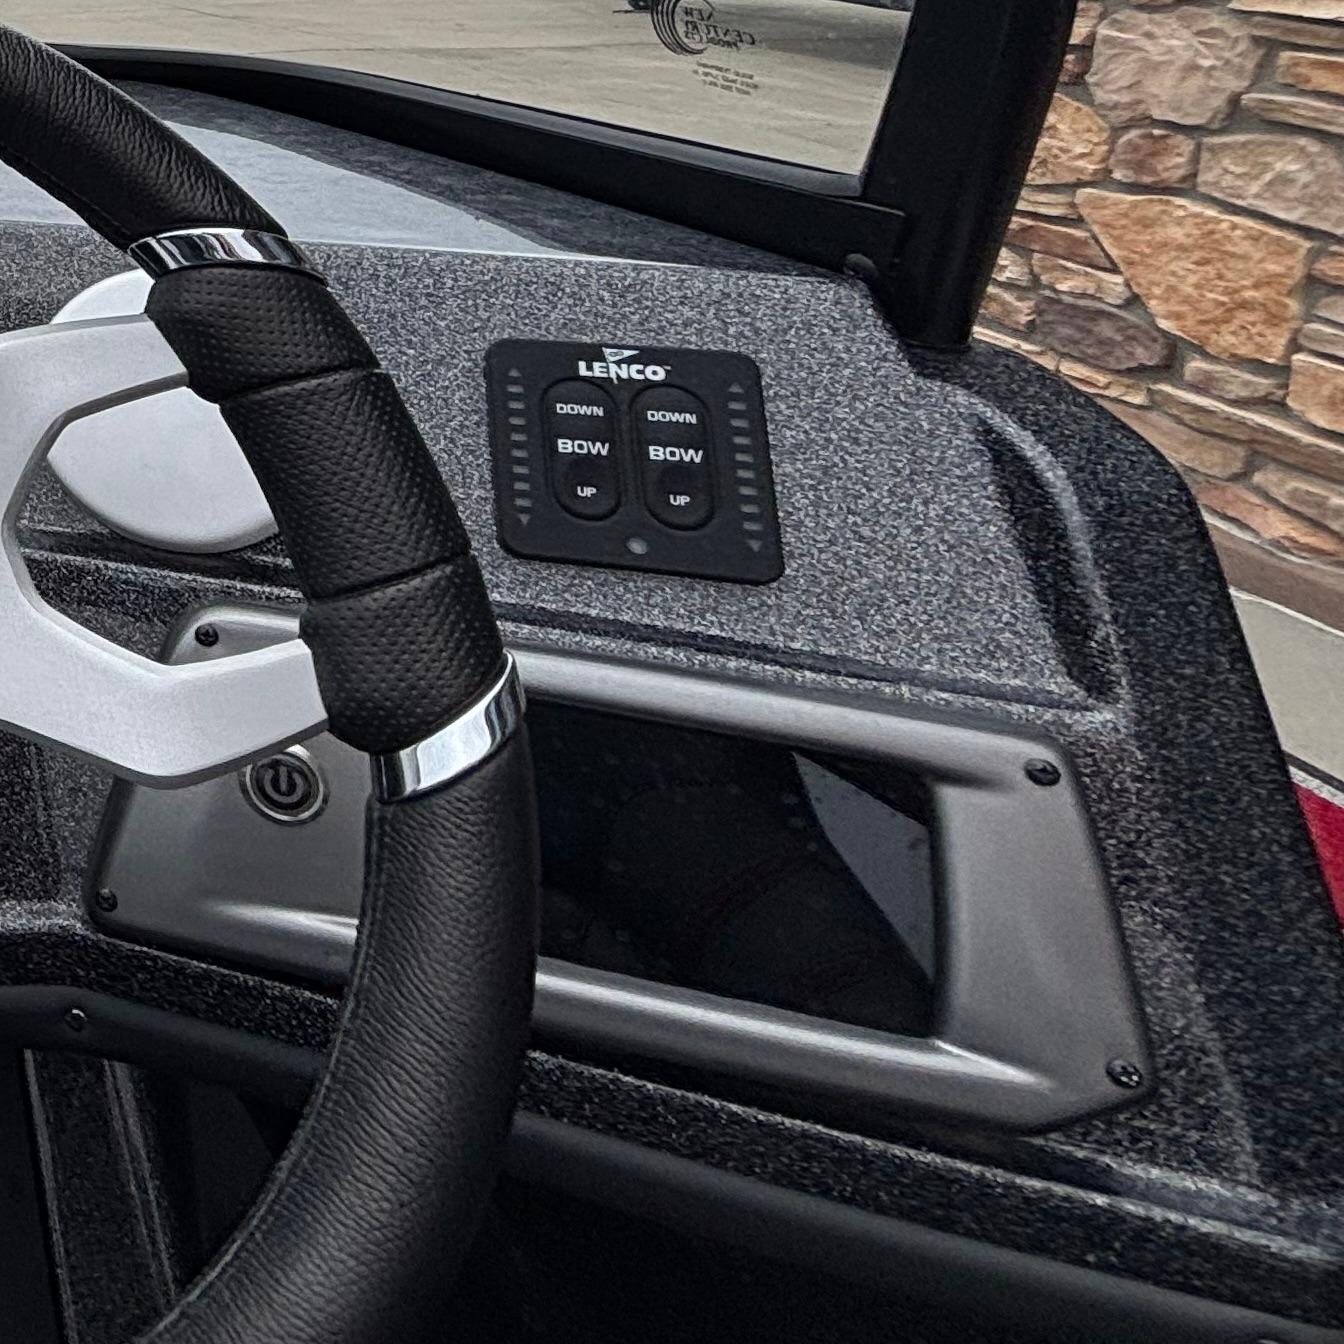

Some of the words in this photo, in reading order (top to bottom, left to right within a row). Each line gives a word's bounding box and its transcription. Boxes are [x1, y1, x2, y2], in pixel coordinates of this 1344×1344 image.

[578, 360, 666, 381] LENCO
[556, 403, 604, 417] DOWN
[647, 410, 697, 424] DOWN
[557, 439, 609, 456] BOW
[648, 445, 703, 464] BOW
[577, 486, 597, 498] UP
[669, 494, 690, 506] UP
